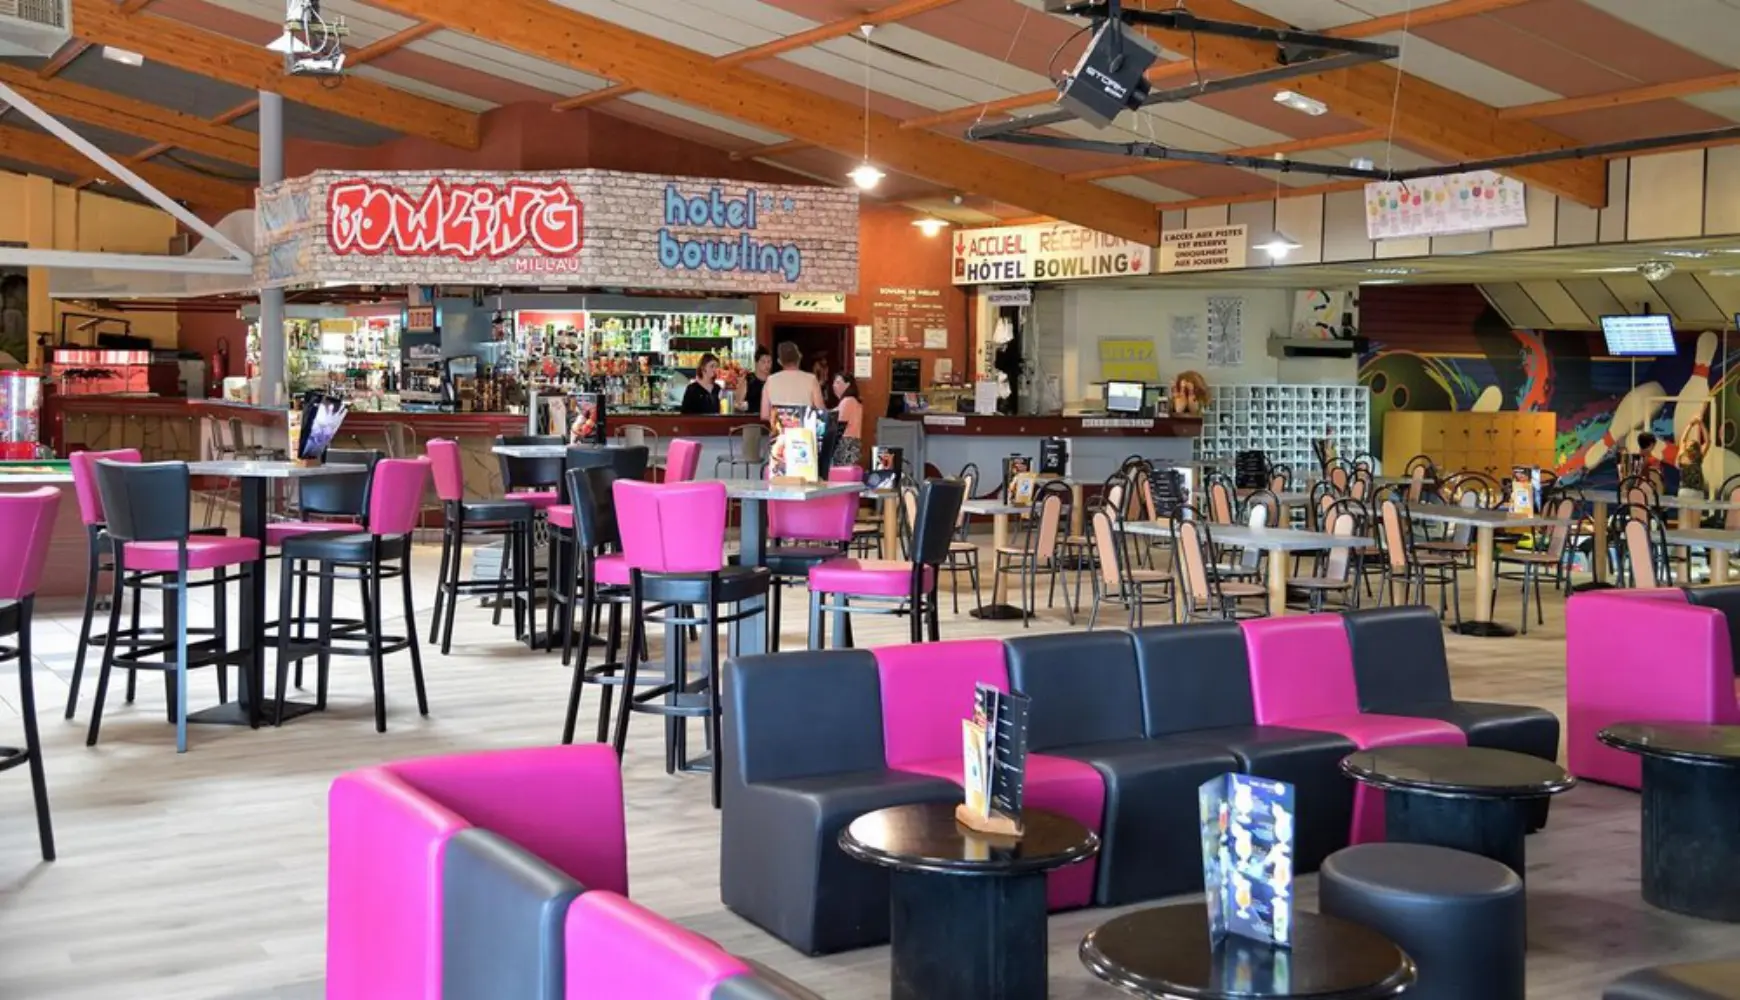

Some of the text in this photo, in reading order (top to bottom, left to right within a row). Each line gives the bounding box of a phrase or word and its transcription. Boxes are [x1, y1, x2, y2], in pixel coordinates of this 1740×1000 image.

[664, 184, 758, 229] hotel
[968, 233, 1027, 257] ACCUEIL
[1215, 228, 1243, 237] PISTES
[514, 257, 580, 273] MILLAU
[657, 227, 802, 283] bowling
[967, 253, 1128, 281] HÔTEL BOWLING
